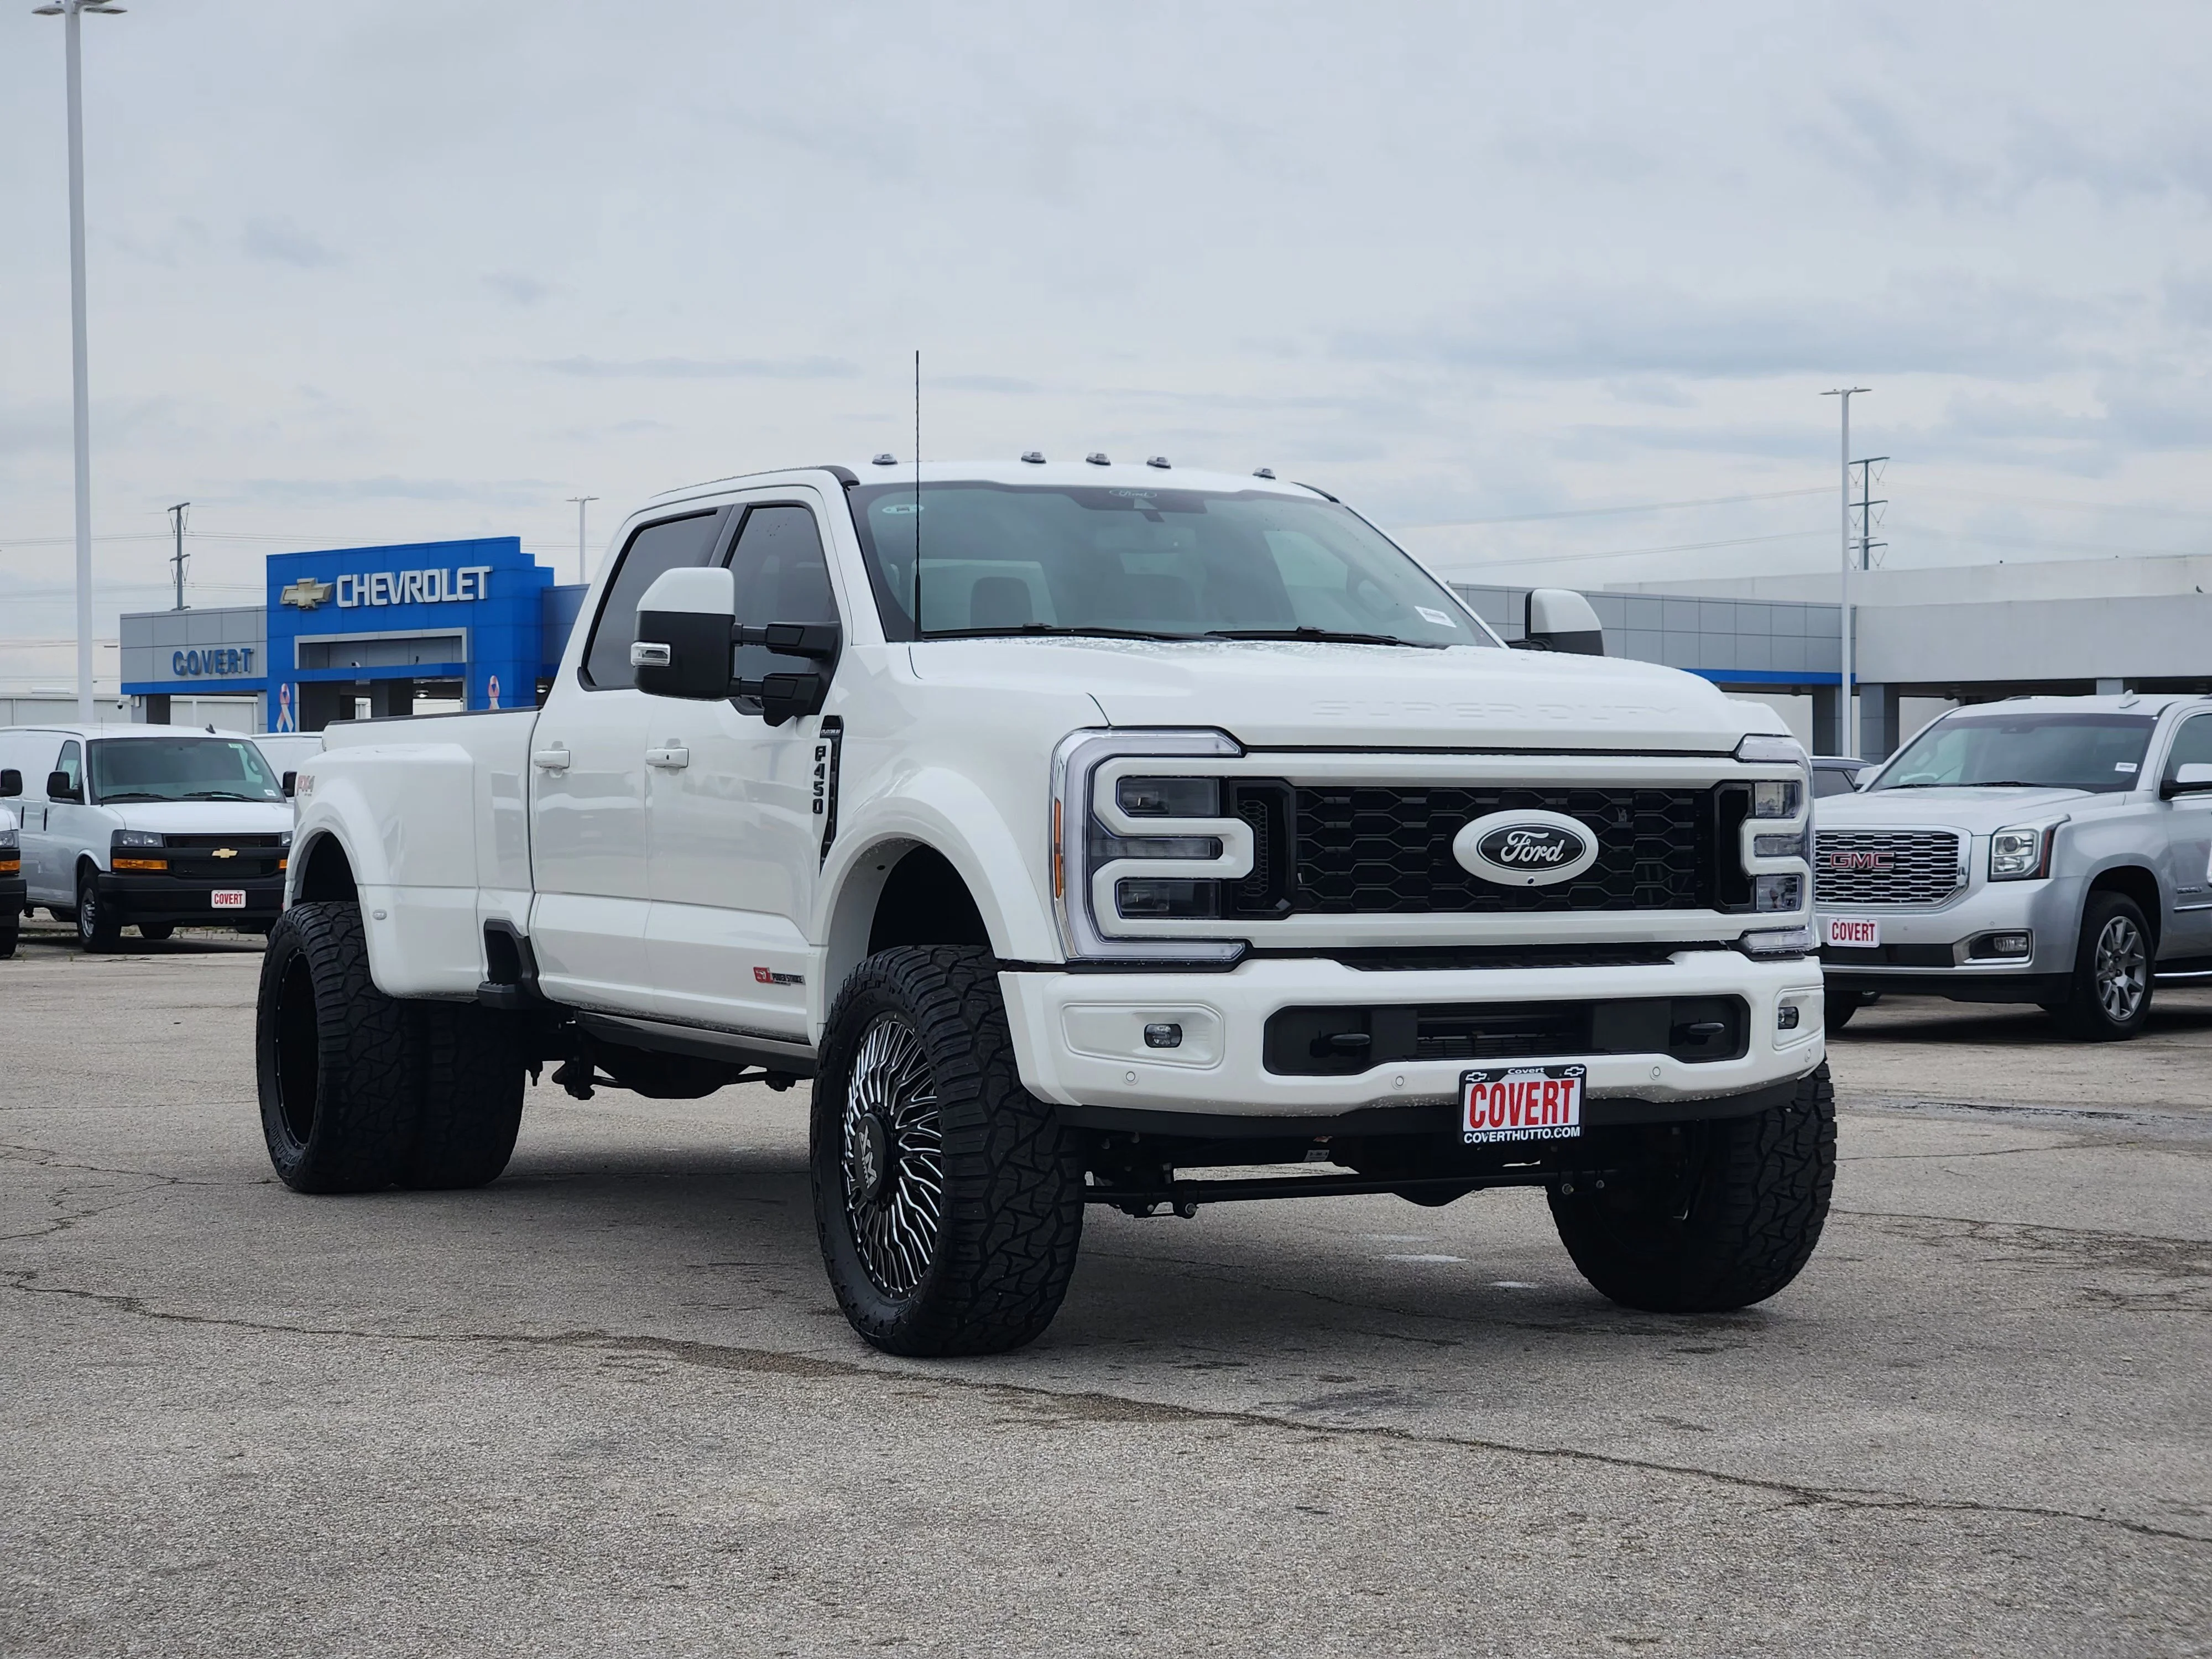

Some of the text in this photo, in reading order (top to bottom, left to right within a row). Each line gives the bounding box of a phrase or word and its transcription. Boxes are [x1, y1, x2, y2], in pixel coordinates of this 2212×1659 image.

[337, 566, 493, 608] CHEVROLET
[173, 648, 253, 676] COVERT
[1500, 831, 1565, 862] Ford
[1830, 851, 1895, 869] GMC
[214, 893, 243, 905] COVERT
[1832, 922, 1876, 941] COVERT
[1469, 1079, 1575, 1129] COVERT
[1464, 1126, 1580, 1144] COVERTHUTTO.COM
